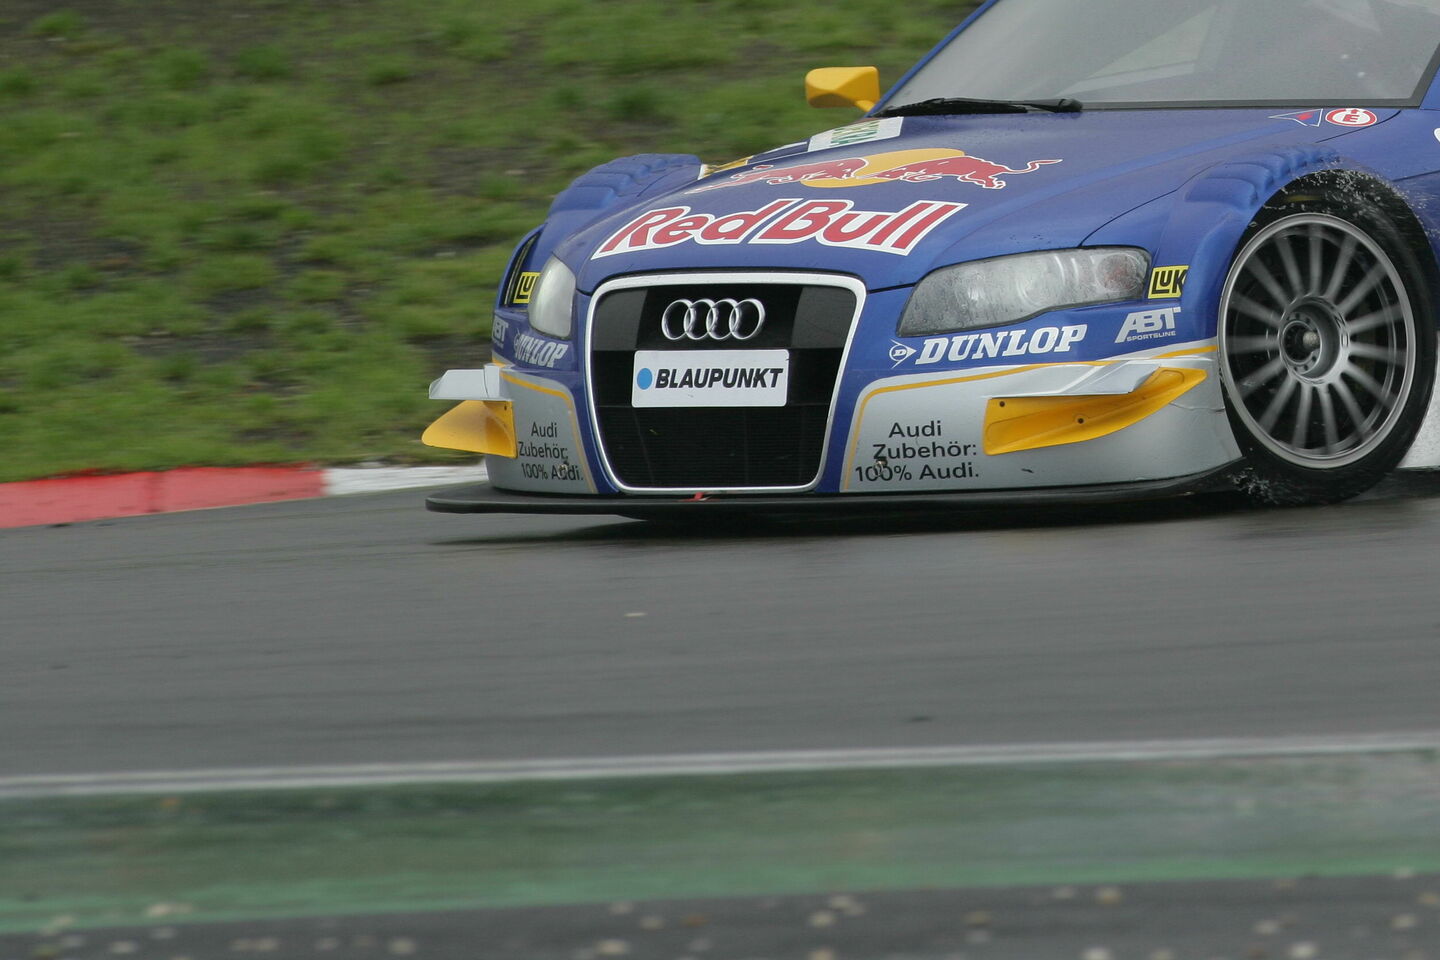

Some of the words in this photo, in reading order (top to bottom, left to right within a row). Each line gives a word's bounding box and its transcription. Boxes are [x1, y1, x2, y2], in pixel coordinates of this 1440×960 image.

[592, 198, 800, 260] Red
[750, 200, 966, 256] Bull
[1115, 307, 1181, 343] ABT
[915, 324, 1088, 365] DUNLOP
[1126, 331, 1177, 342] SPORTSLINE
[655, 368, 784, 389] BLAUPUNKT
[531, 421, 557, 438] Audi
[888, 420, 941, 438] Audi
[518, 441, 568, 460] Zubehör:
[872, 441, 977, 460] Zubehör:
[521, 463, 548, 481] 100%
[855, 465, 912, 482] 100%
[919, 461, 979, 480] Audi.
